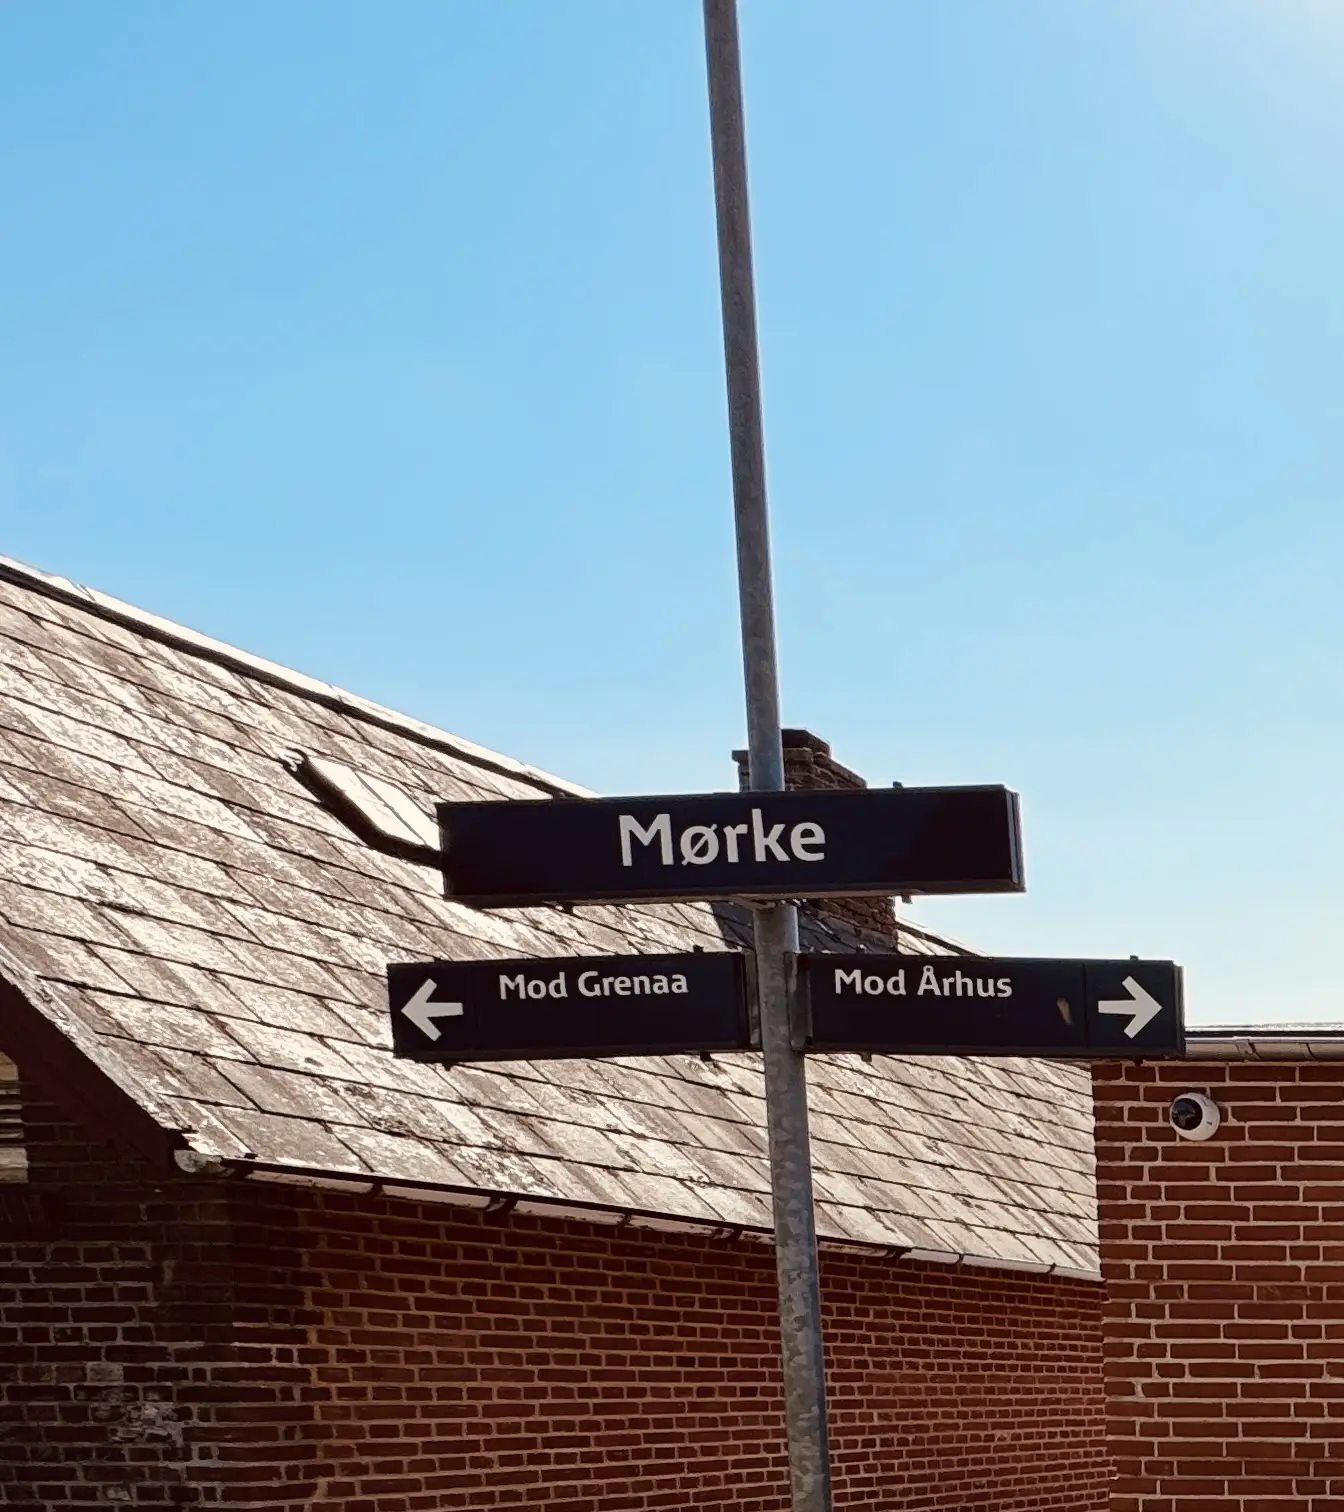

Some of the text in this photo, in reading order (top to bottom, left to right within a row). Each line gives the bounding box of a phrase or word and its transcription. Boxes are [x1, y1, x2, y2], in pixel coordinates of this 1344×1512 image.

[619, 808, 826, 867] Mørke
[499, 970, 689, 1000] Mod Grenaa
[834, 965, 1013, 998] Mod Århus
